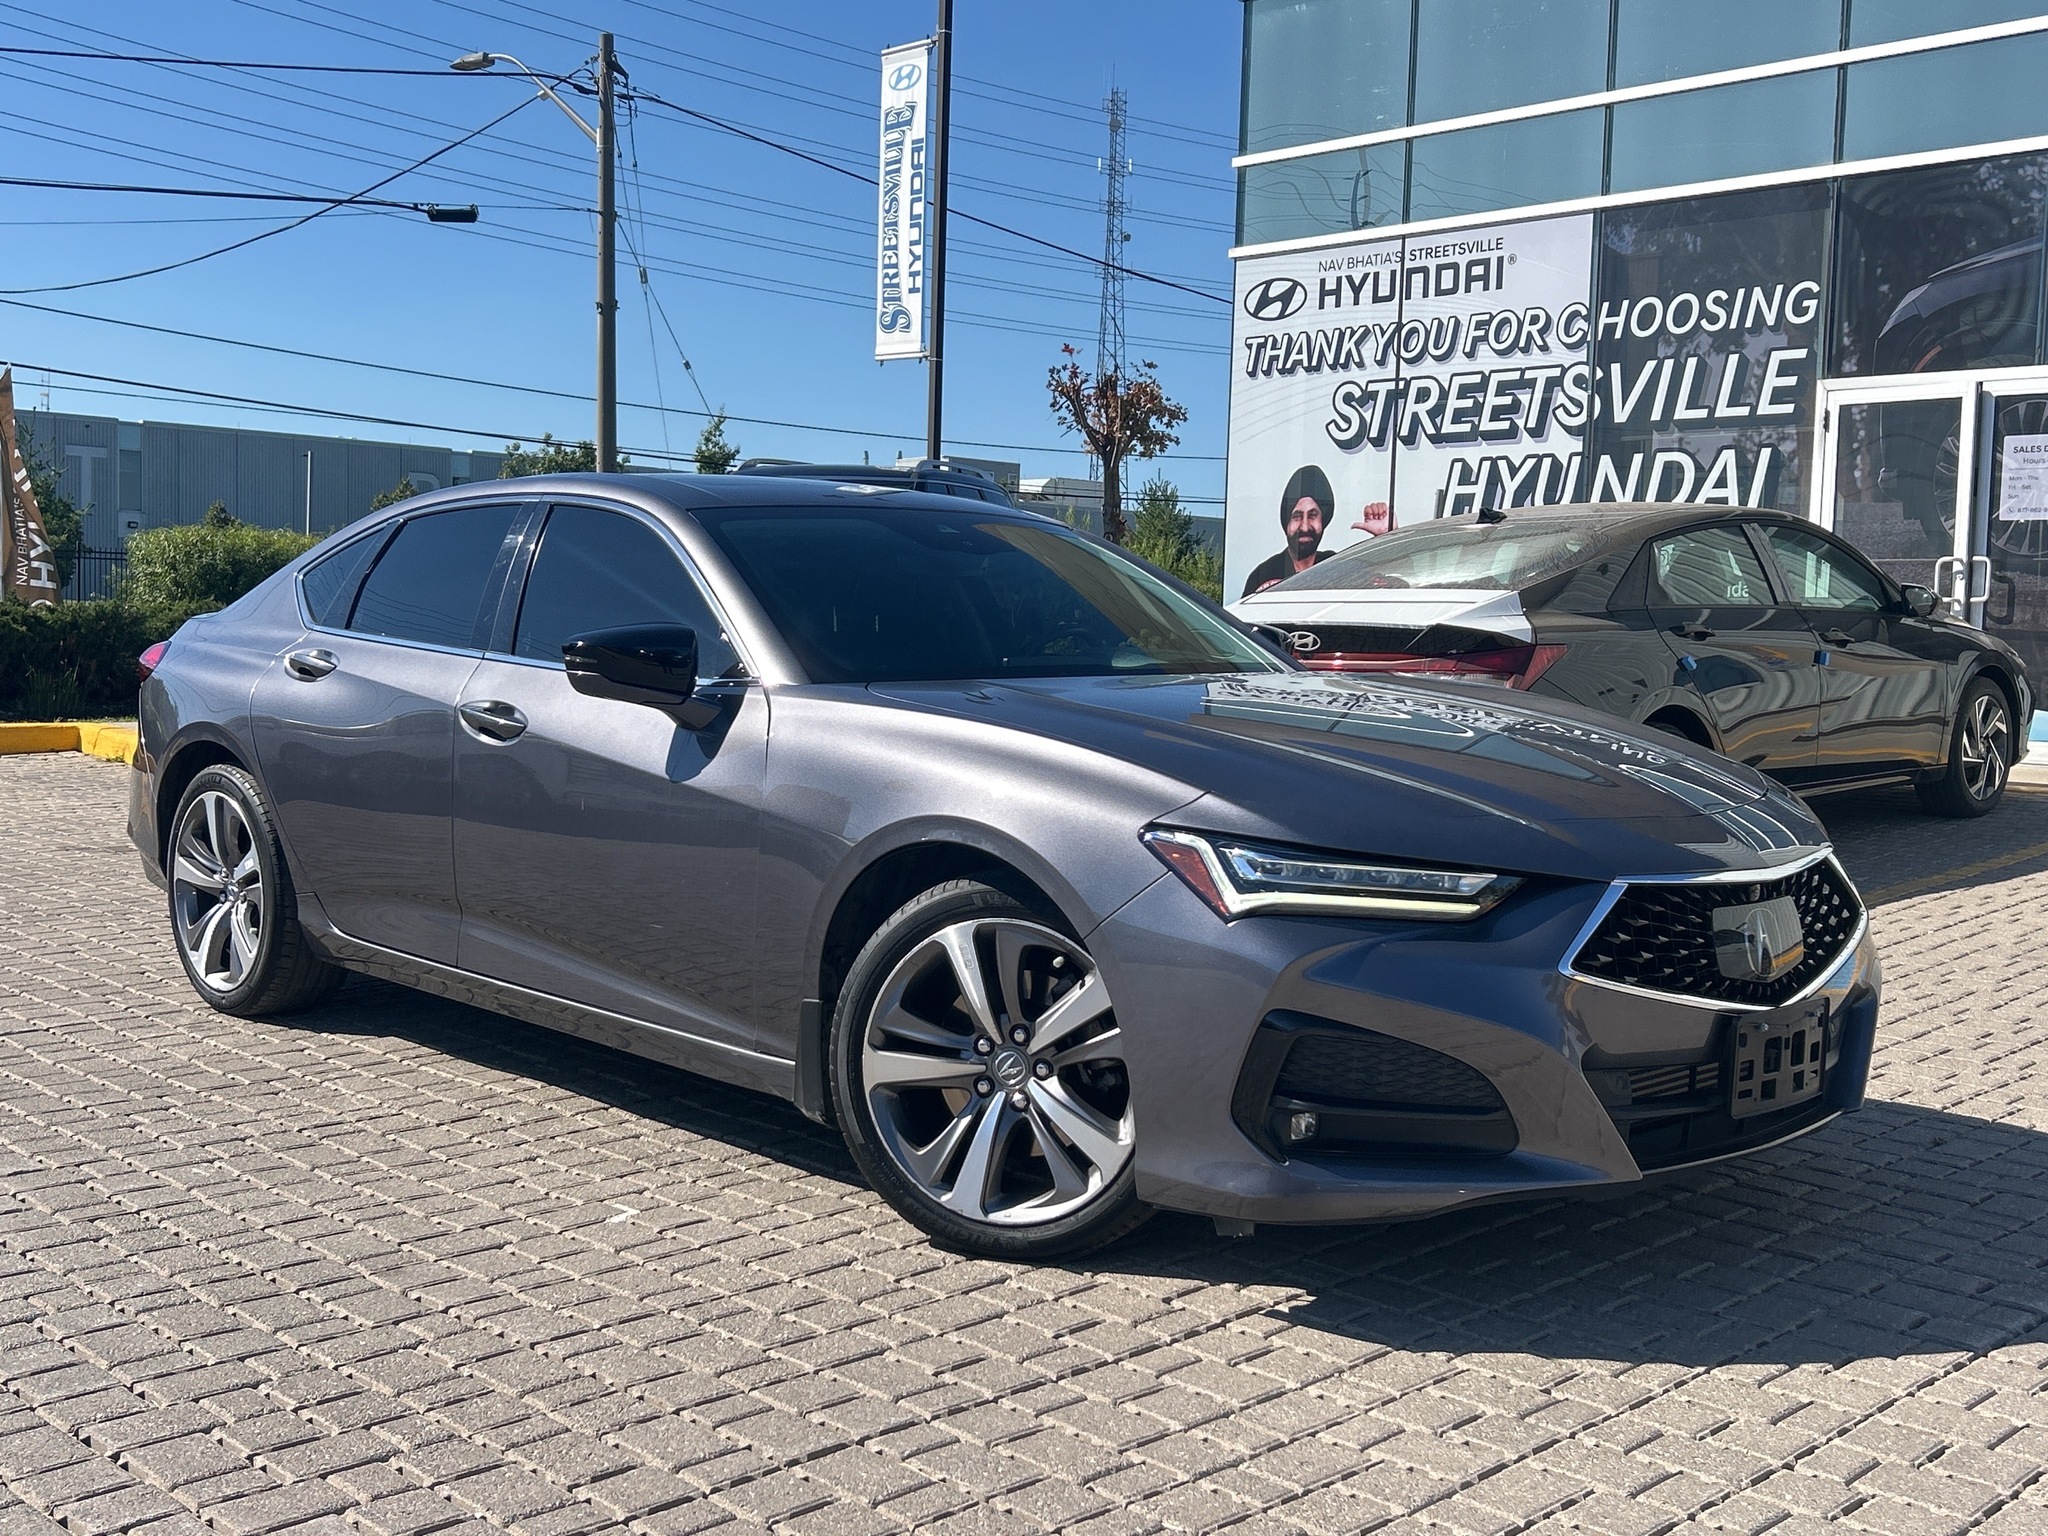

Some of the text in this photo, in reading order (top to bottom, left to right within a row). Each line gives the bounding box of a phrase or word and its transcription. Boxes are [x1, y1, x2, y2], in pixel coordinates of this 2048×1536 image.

[879, 101, 918, 334] STREETSVILLE
[908, 137, 925, 294] HYUNDAI
[1318, 237, 1504, 273] NAV BHATIA'S STREETSVILLE
[1245, 280, 1821, 376] THANK YOU FOR CHOOSING
[1326, 347, 1809, 446] STREETSVILLE
[1443, 446, 1773, 517] HYUNDAI
[2013, 445, 2042, 454] SALES
[15, 557, 28, 586] NAV
